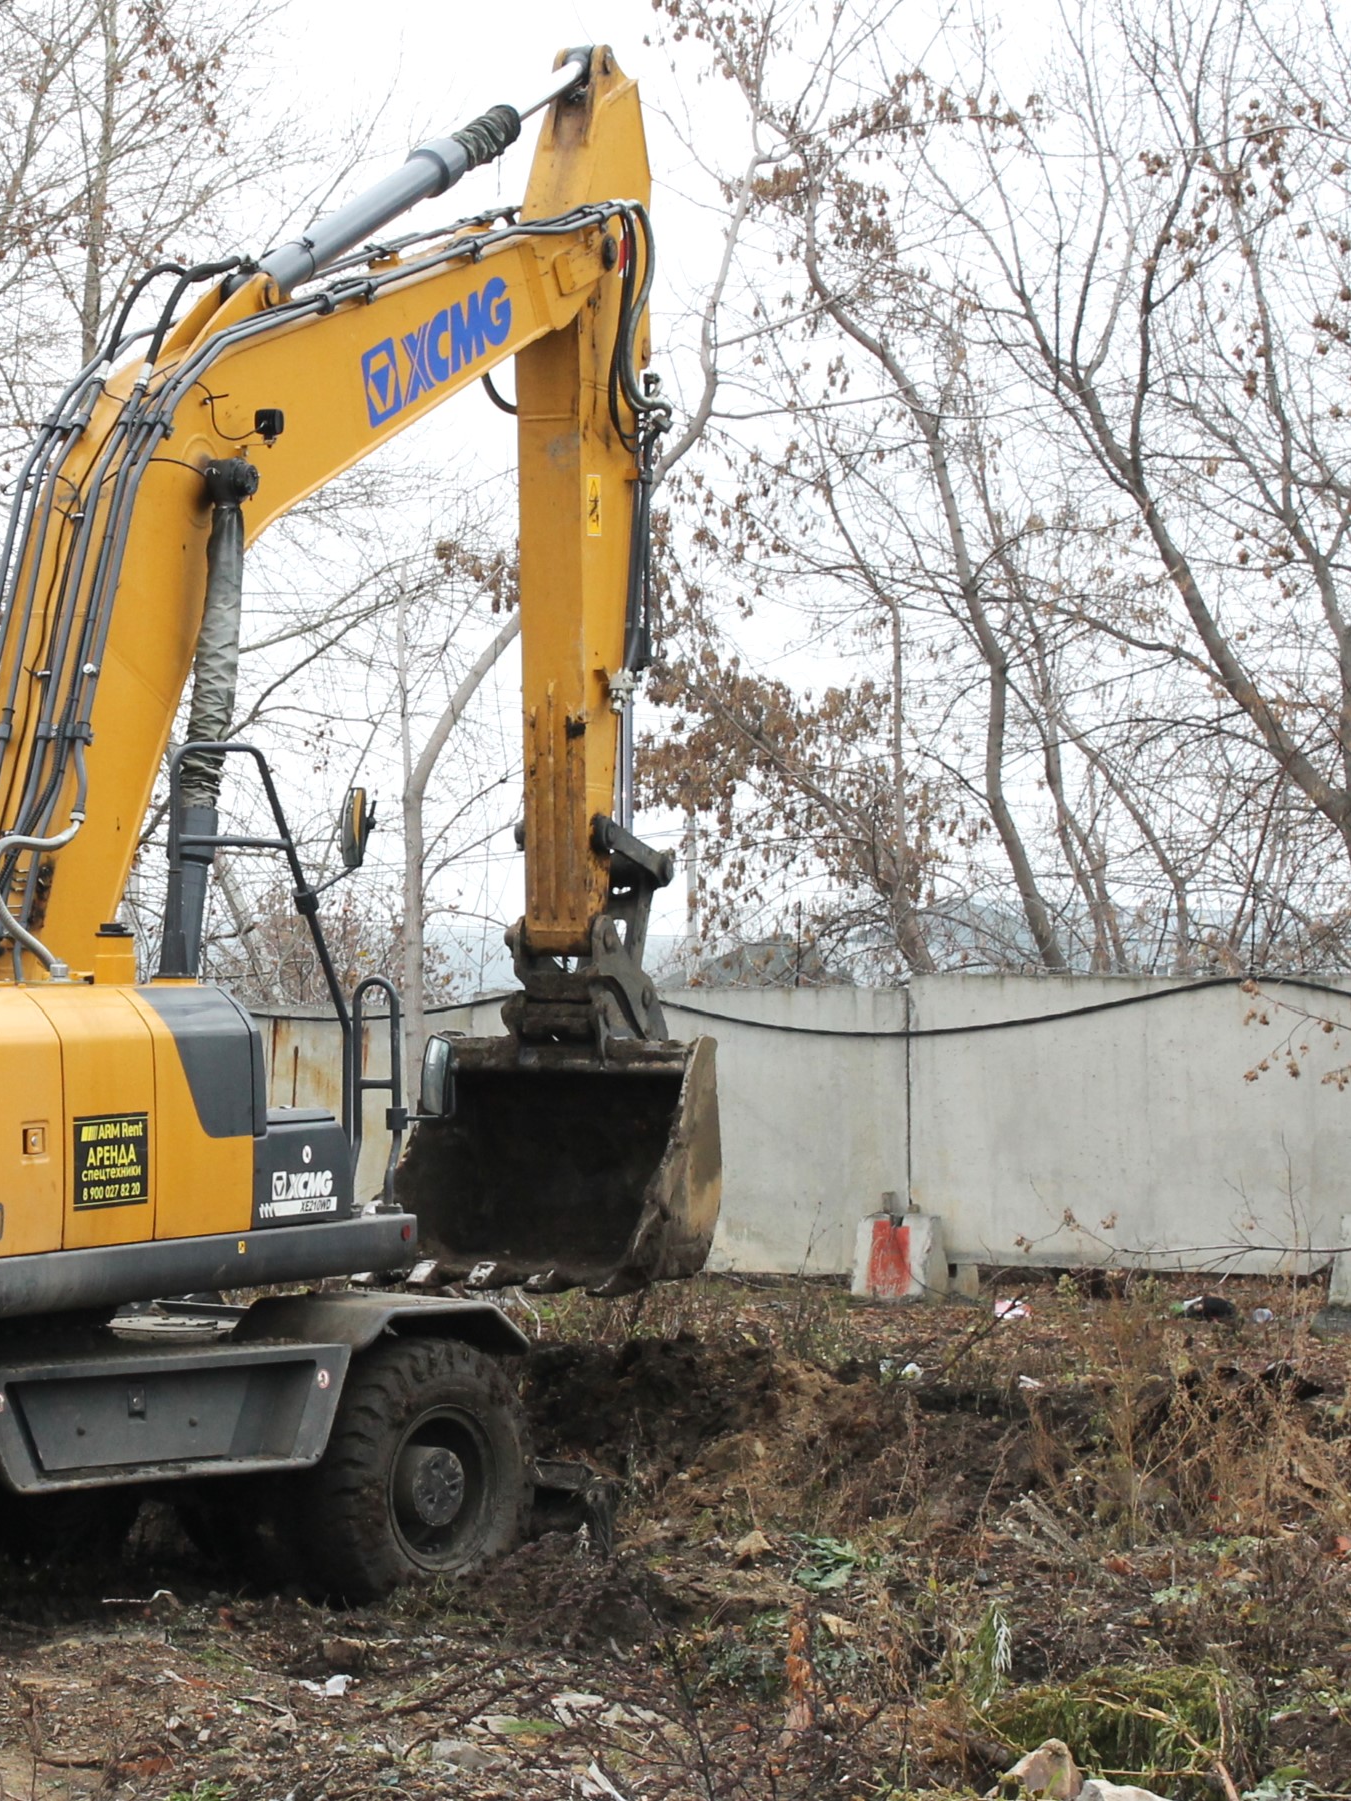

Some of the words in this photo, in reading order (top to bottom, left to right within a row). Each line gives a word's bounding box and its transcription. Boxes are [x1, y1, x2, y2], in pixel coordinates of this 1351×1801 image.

[401, 276, 512, 408] XCMG
[98, 1123, 120, 1140] ARM
[122, 1121, 143, 1138] Rent
[86, 1143, 137, 1168] АРЕНДА
[81, 1165, 142, 1182] спецтехники
[82, 1187, 89, 1201] 8
[90, 1185, 104, 1200] 900
[105, 1184, 119, 1198] 027
[120, 1183, 130, 1197] 82
[131, 1182, 141, 1196] 20
[286, 1170, 333, 1199] XCMG
[300, 1199, 331, 1213] XE210WD
